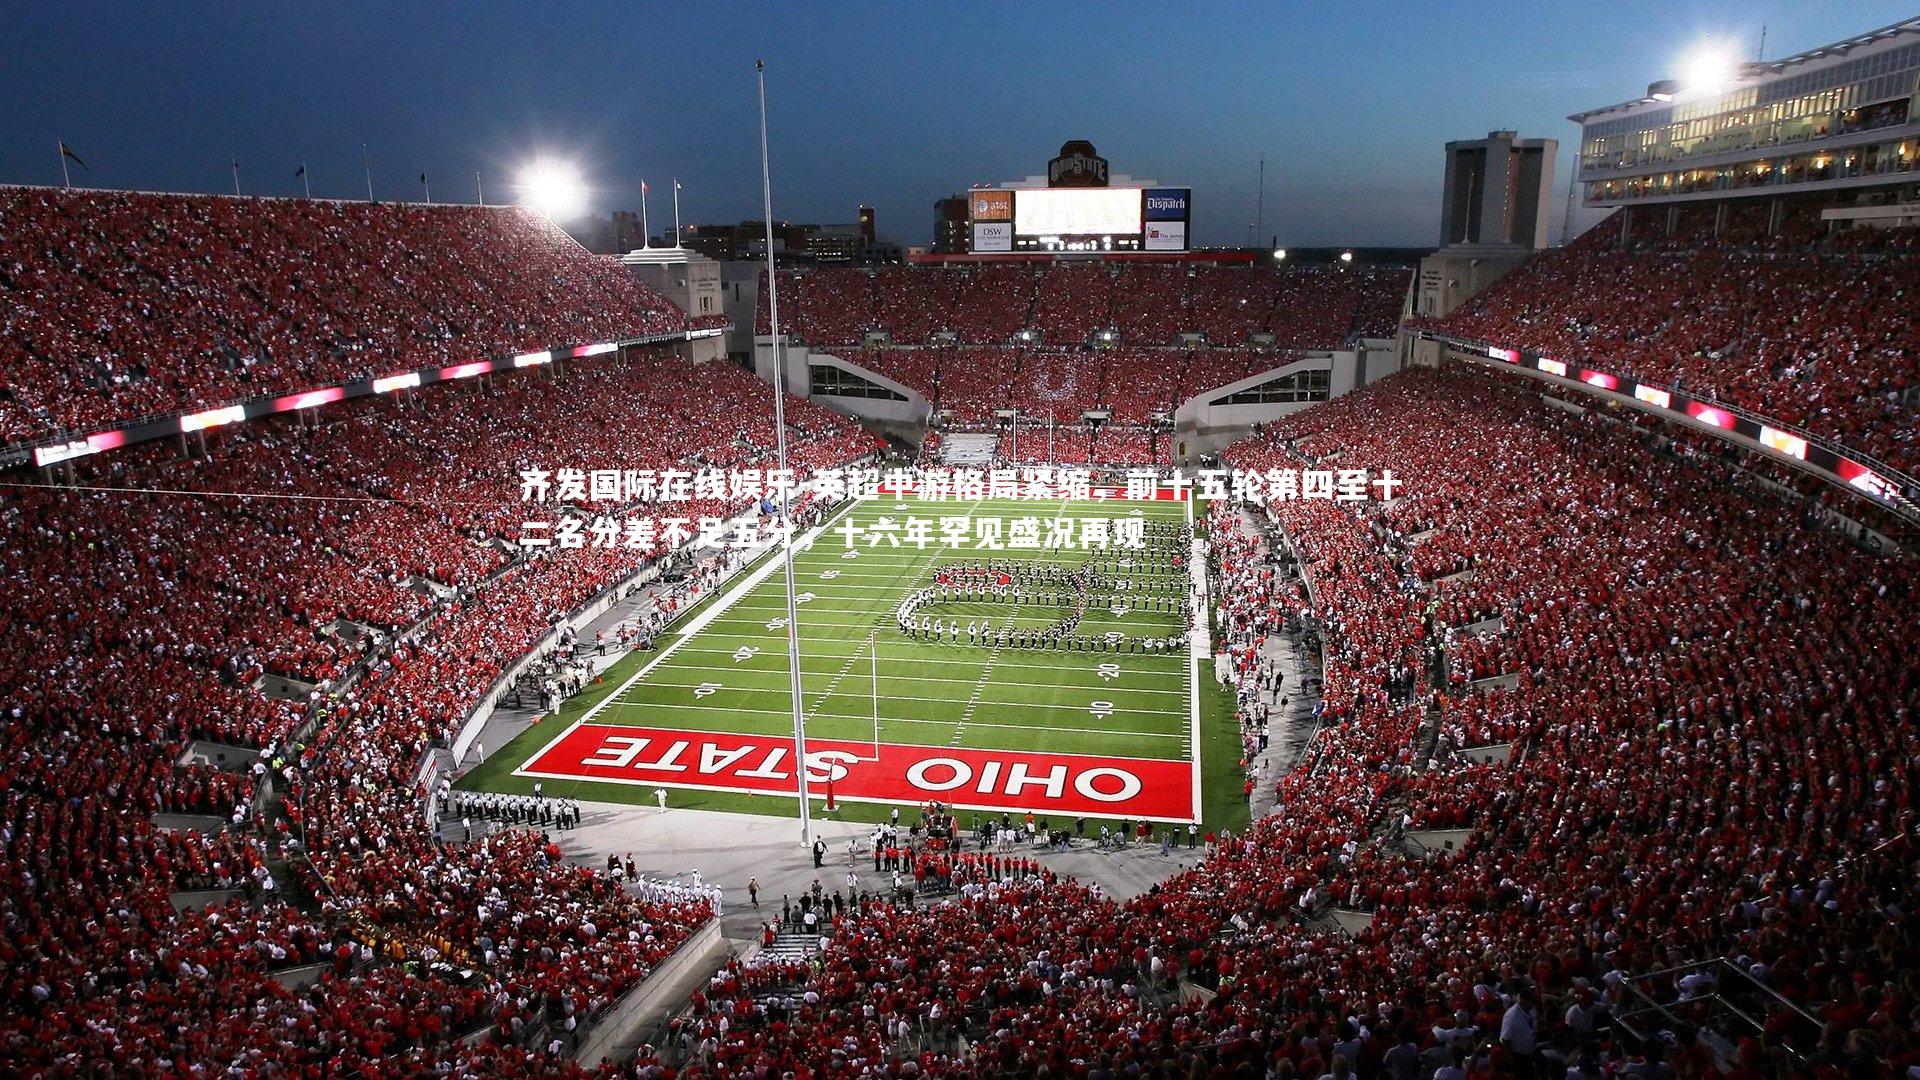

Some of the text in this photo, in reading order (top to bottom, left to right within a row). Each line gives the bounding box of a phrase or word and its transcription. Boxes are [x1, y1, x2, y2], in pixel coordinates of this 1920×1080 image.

[1148, 197, 1185, 210] Dispatch
[1098, 664, 1120, 677] 20
[1089, 701, 1114, 714] 10
[580, 735, 1142, 802] OHIO STATE
